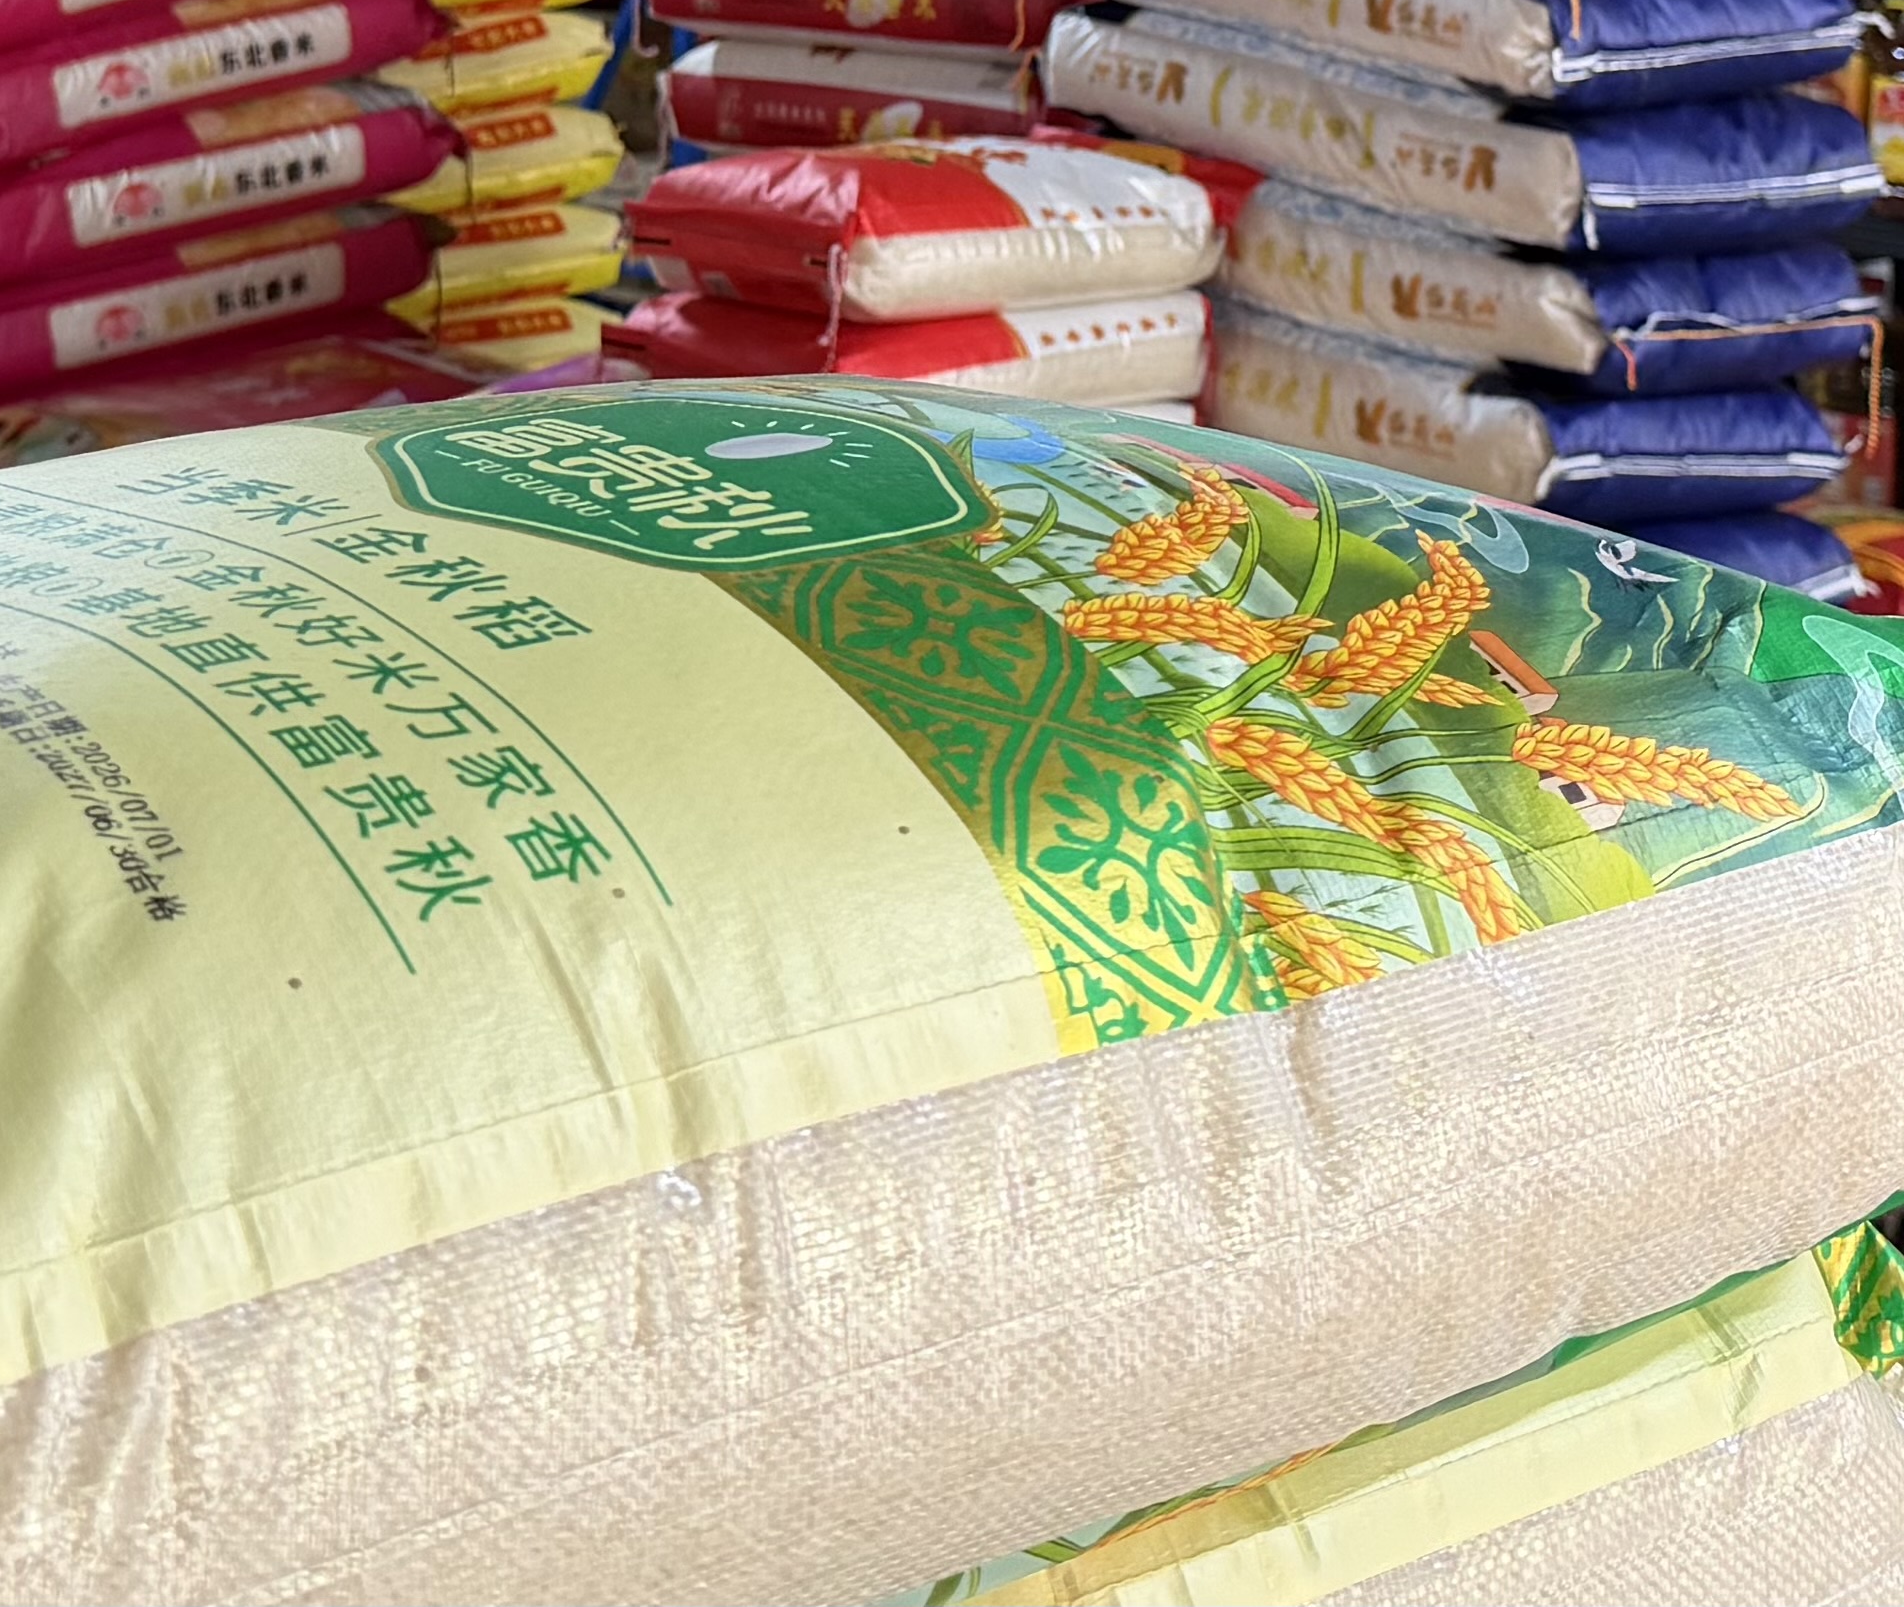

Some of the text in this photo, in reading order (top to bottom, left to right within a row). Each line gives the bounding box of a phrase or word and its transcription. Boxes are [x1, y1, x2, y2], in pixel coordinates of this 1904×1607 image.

[446, 418, 814, 550] 富贵秋
[461, 457, 613, 518] FU GUIQIU
[312, 524, 594, 653] 金秋稻
[62, 584, 496, 923] 基地直供富贵秋
[174, 560, 614, 888] 金秋好米万家香
